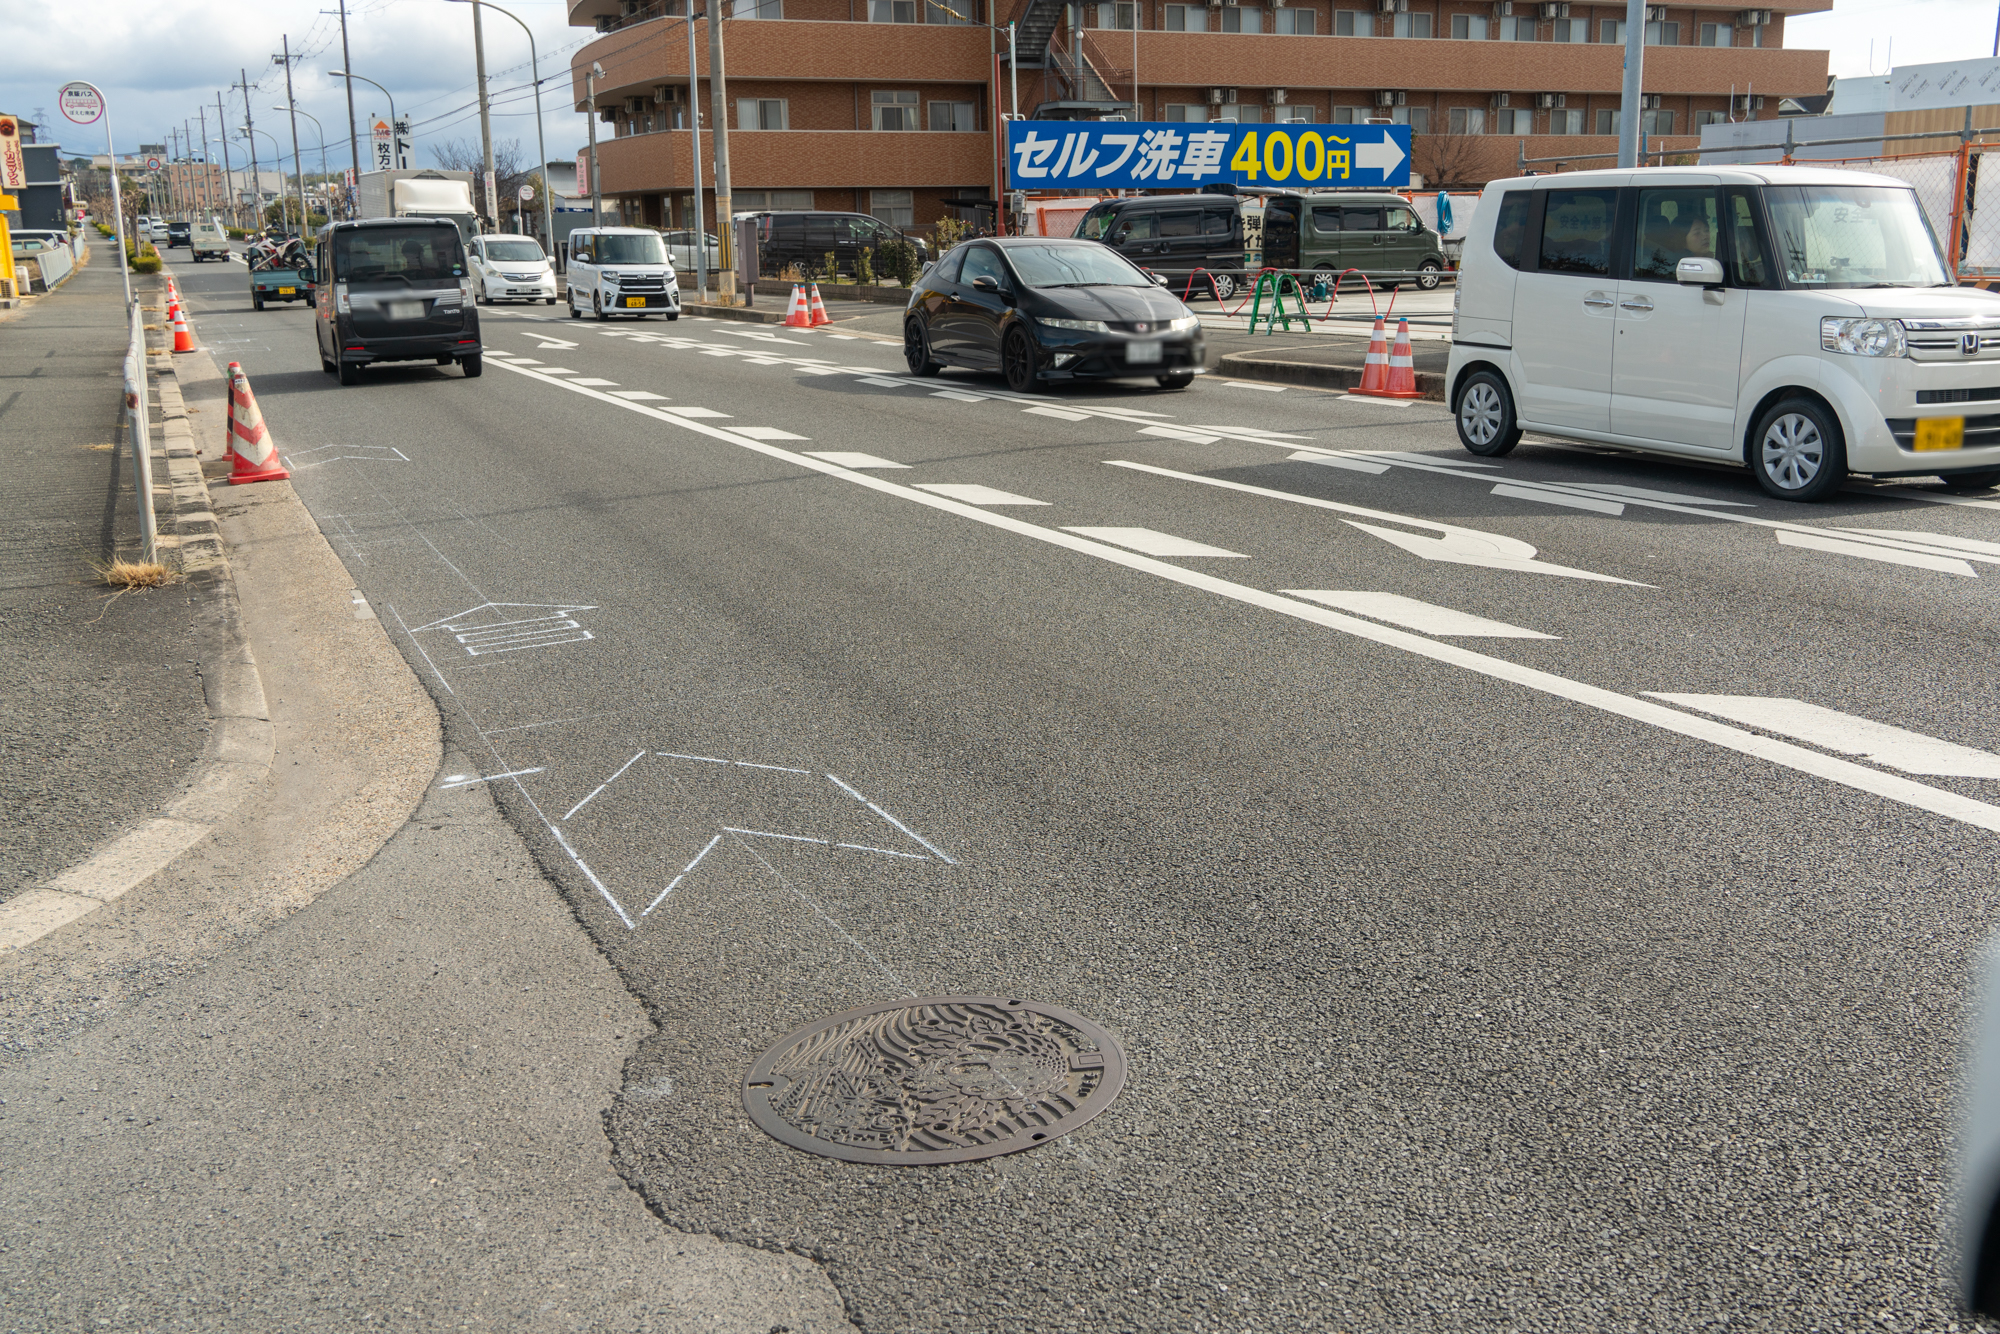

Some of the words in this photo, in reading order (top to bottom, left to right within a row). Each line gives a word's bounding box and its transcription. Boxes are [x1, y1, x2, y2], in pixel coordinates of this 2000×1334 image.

[1013, 128, 1231, 181] セルフ洗車
